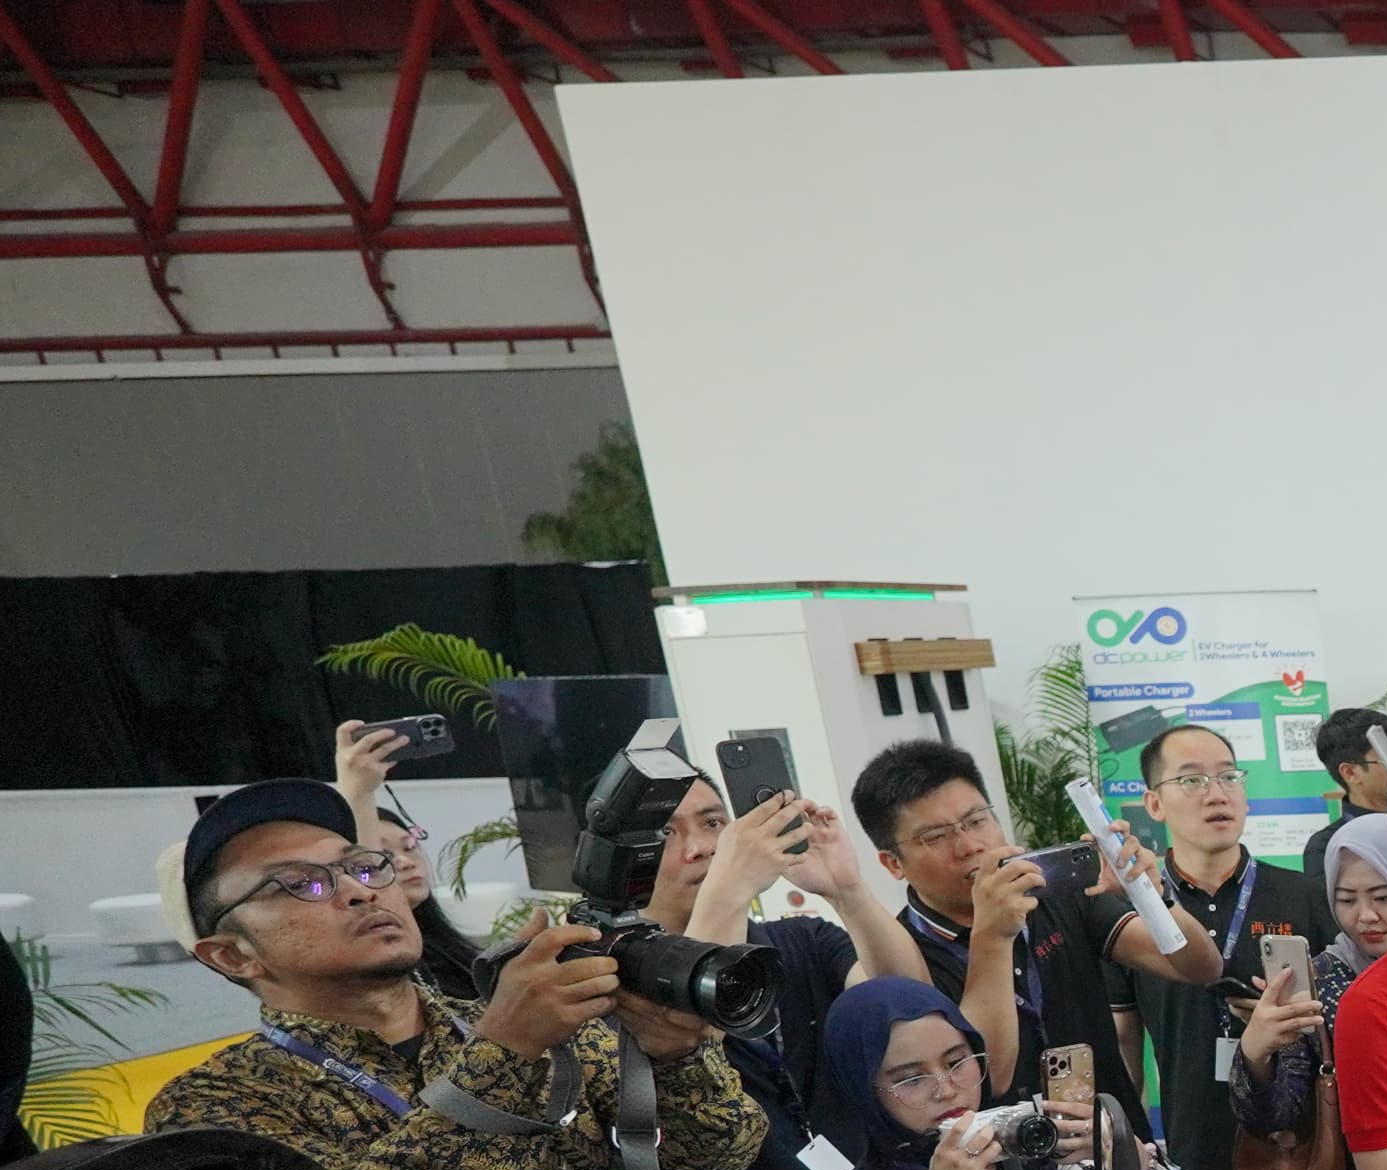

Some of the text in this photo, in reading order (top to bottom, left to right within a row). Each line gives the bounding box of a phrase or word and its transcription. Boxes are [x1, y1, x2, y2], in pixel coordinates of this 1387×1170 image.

[1215, 640, 1252, 652] Charger
[1093, 650, 1187, 665] dcpower
[1270, 649, 1315, 659] Wheelers
[1094, 685, 1190, 699] Portable Charger
[1110, 782, 1126, 793] AC
